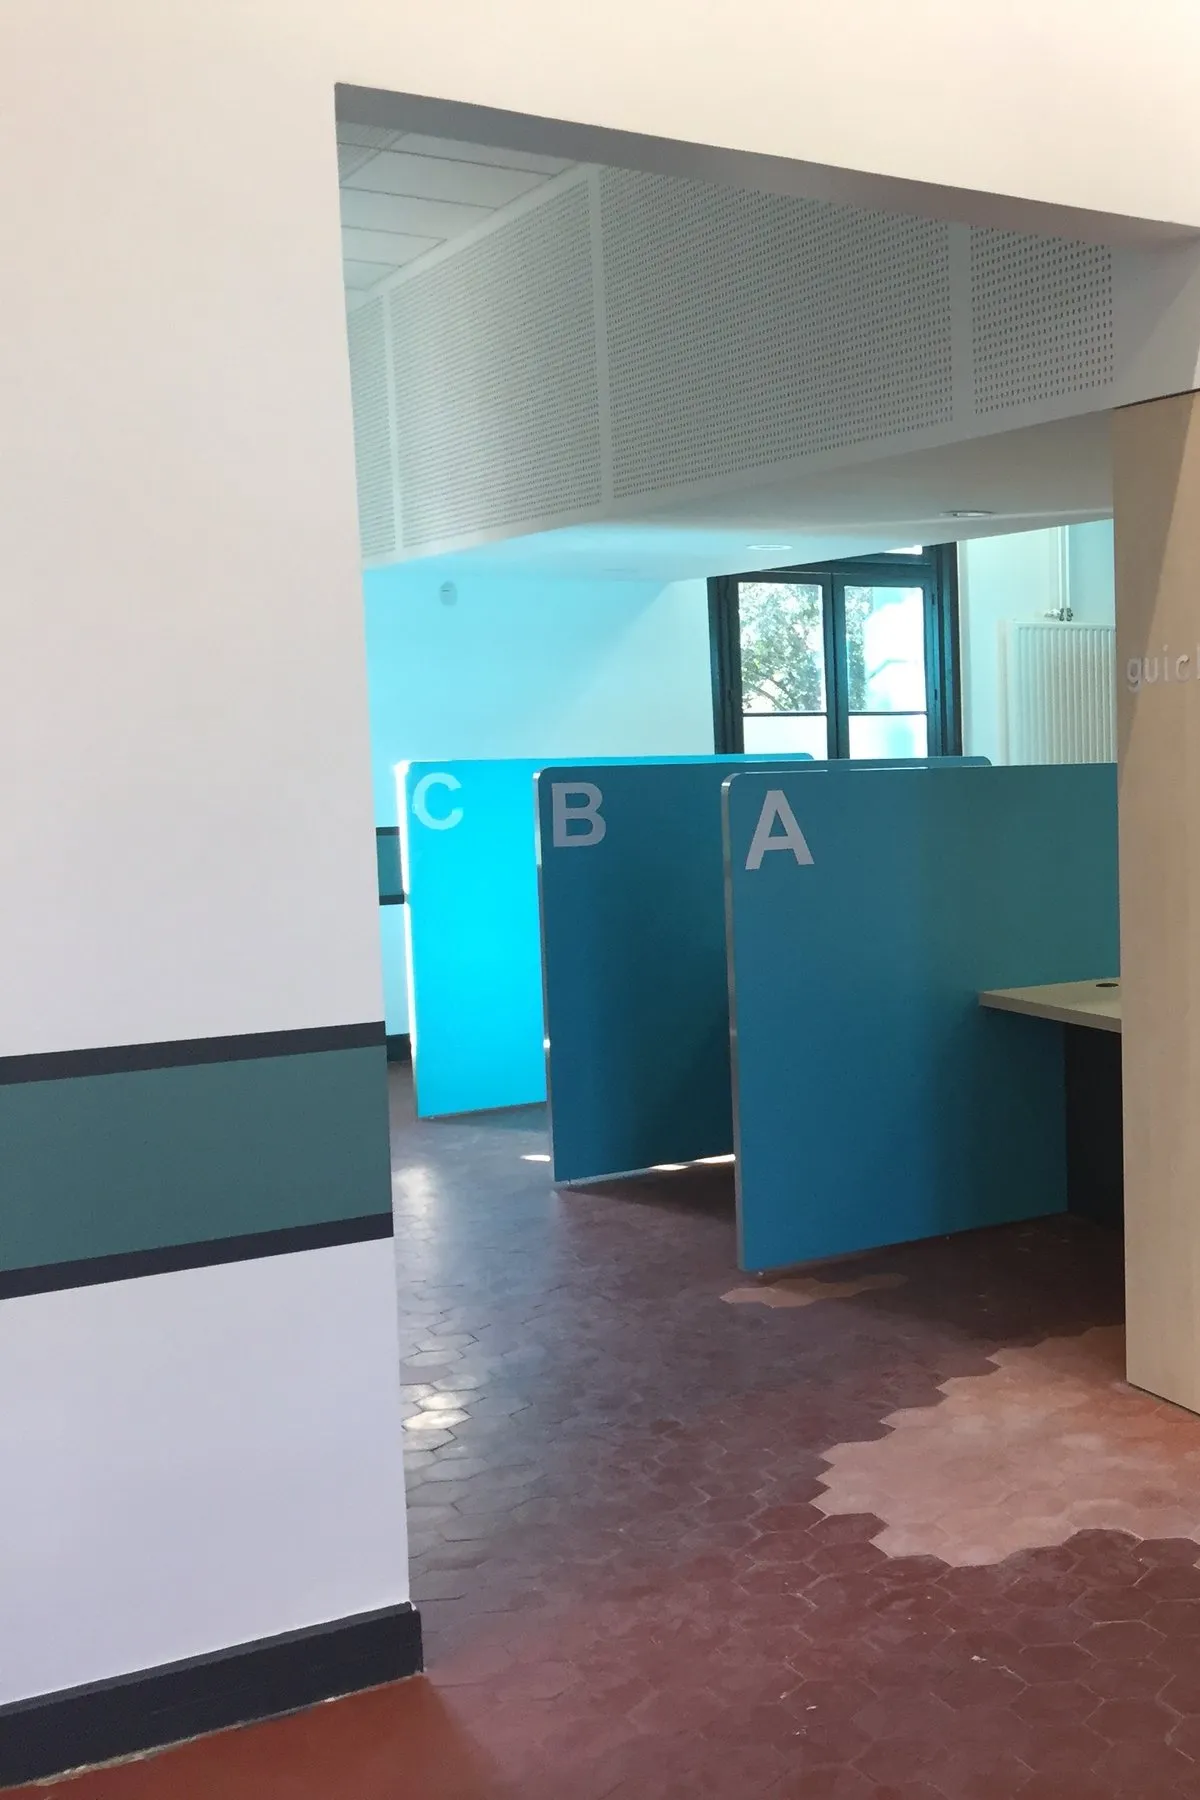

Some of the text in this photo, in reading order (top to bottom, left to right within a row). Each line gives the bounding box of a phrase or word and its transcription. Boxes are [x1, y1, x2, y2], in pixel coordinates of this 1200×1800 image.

[411, 772, 463, 831] C
[550, 783, 607, 848] B
[744, 790, 815, 870] A
